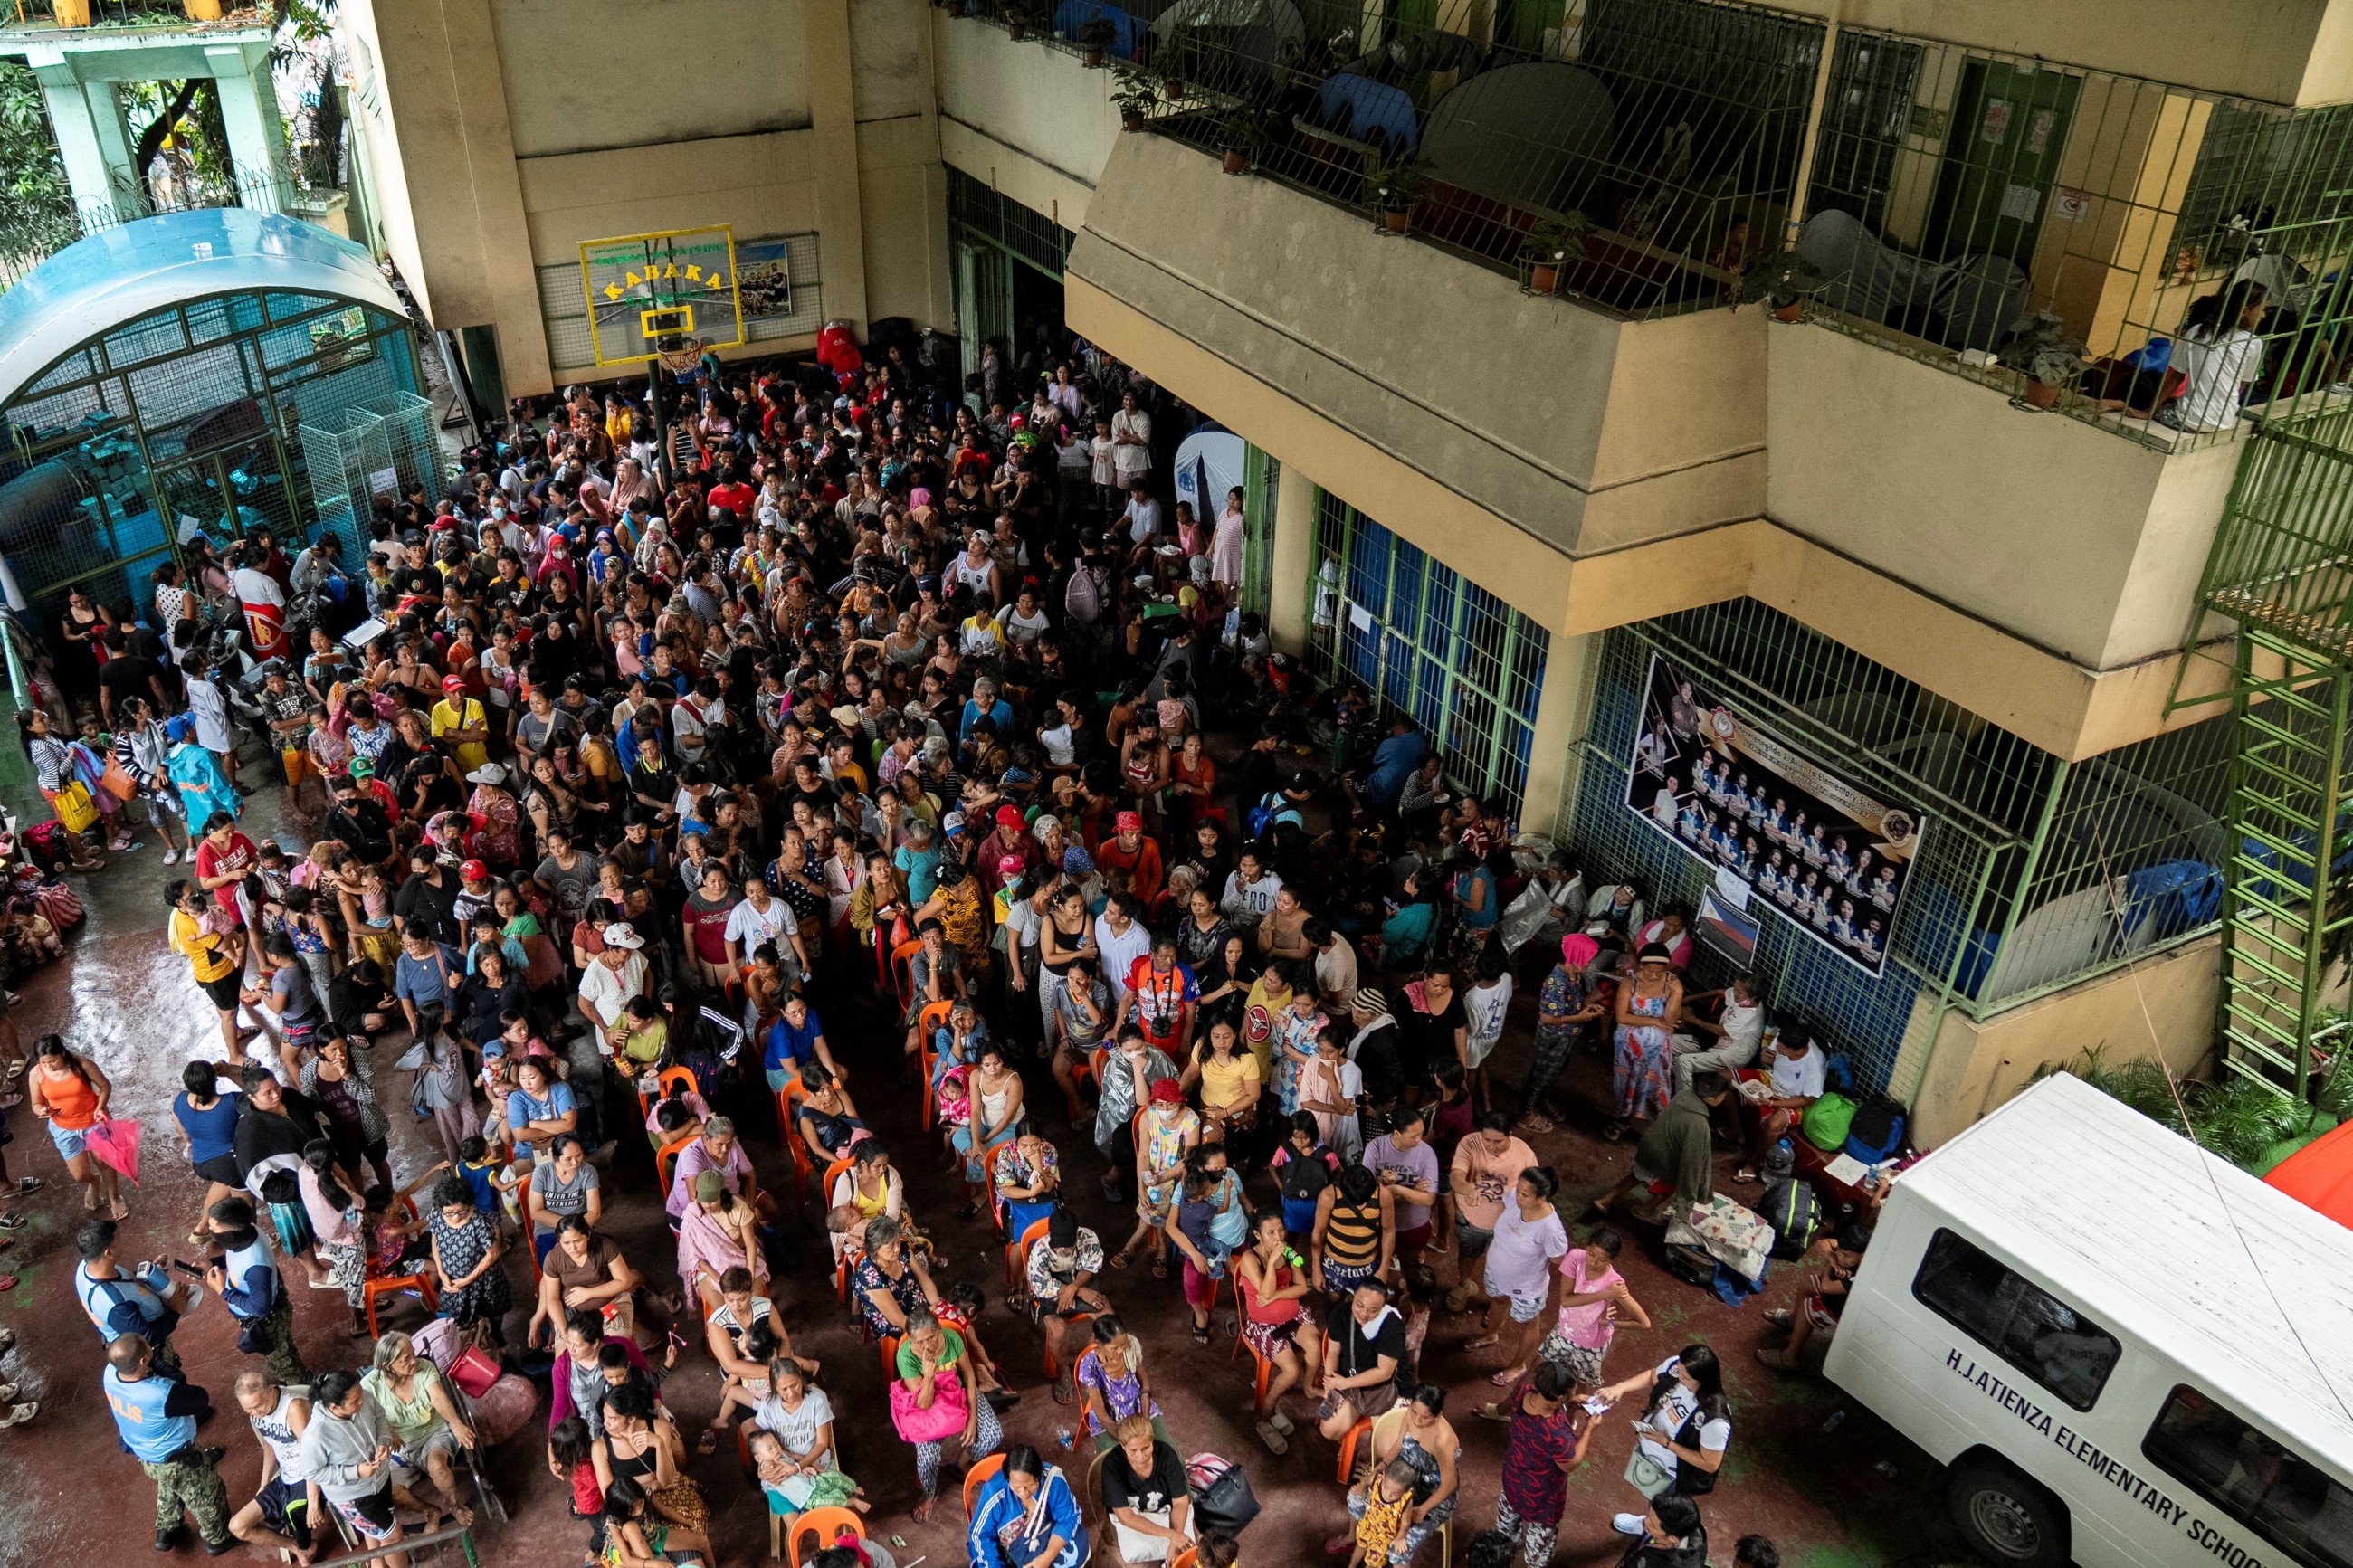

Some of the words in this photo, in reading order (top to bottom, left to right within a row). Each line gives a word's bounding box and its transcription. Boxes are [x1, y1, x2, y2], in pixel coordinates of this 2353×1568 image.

[603, 263, 721, 301] KABAKA
[1816, 774, 1859, 803] Elementary
[1858, 795, 1887, 818] School
[545, 1190, 566, 1200] ENTER
[567, 1188, 580, 1199] THE
[546, 1199, 579, 1207] WEEKEND
[2054, 1425, 2189, 1526] ELEMENTARY
